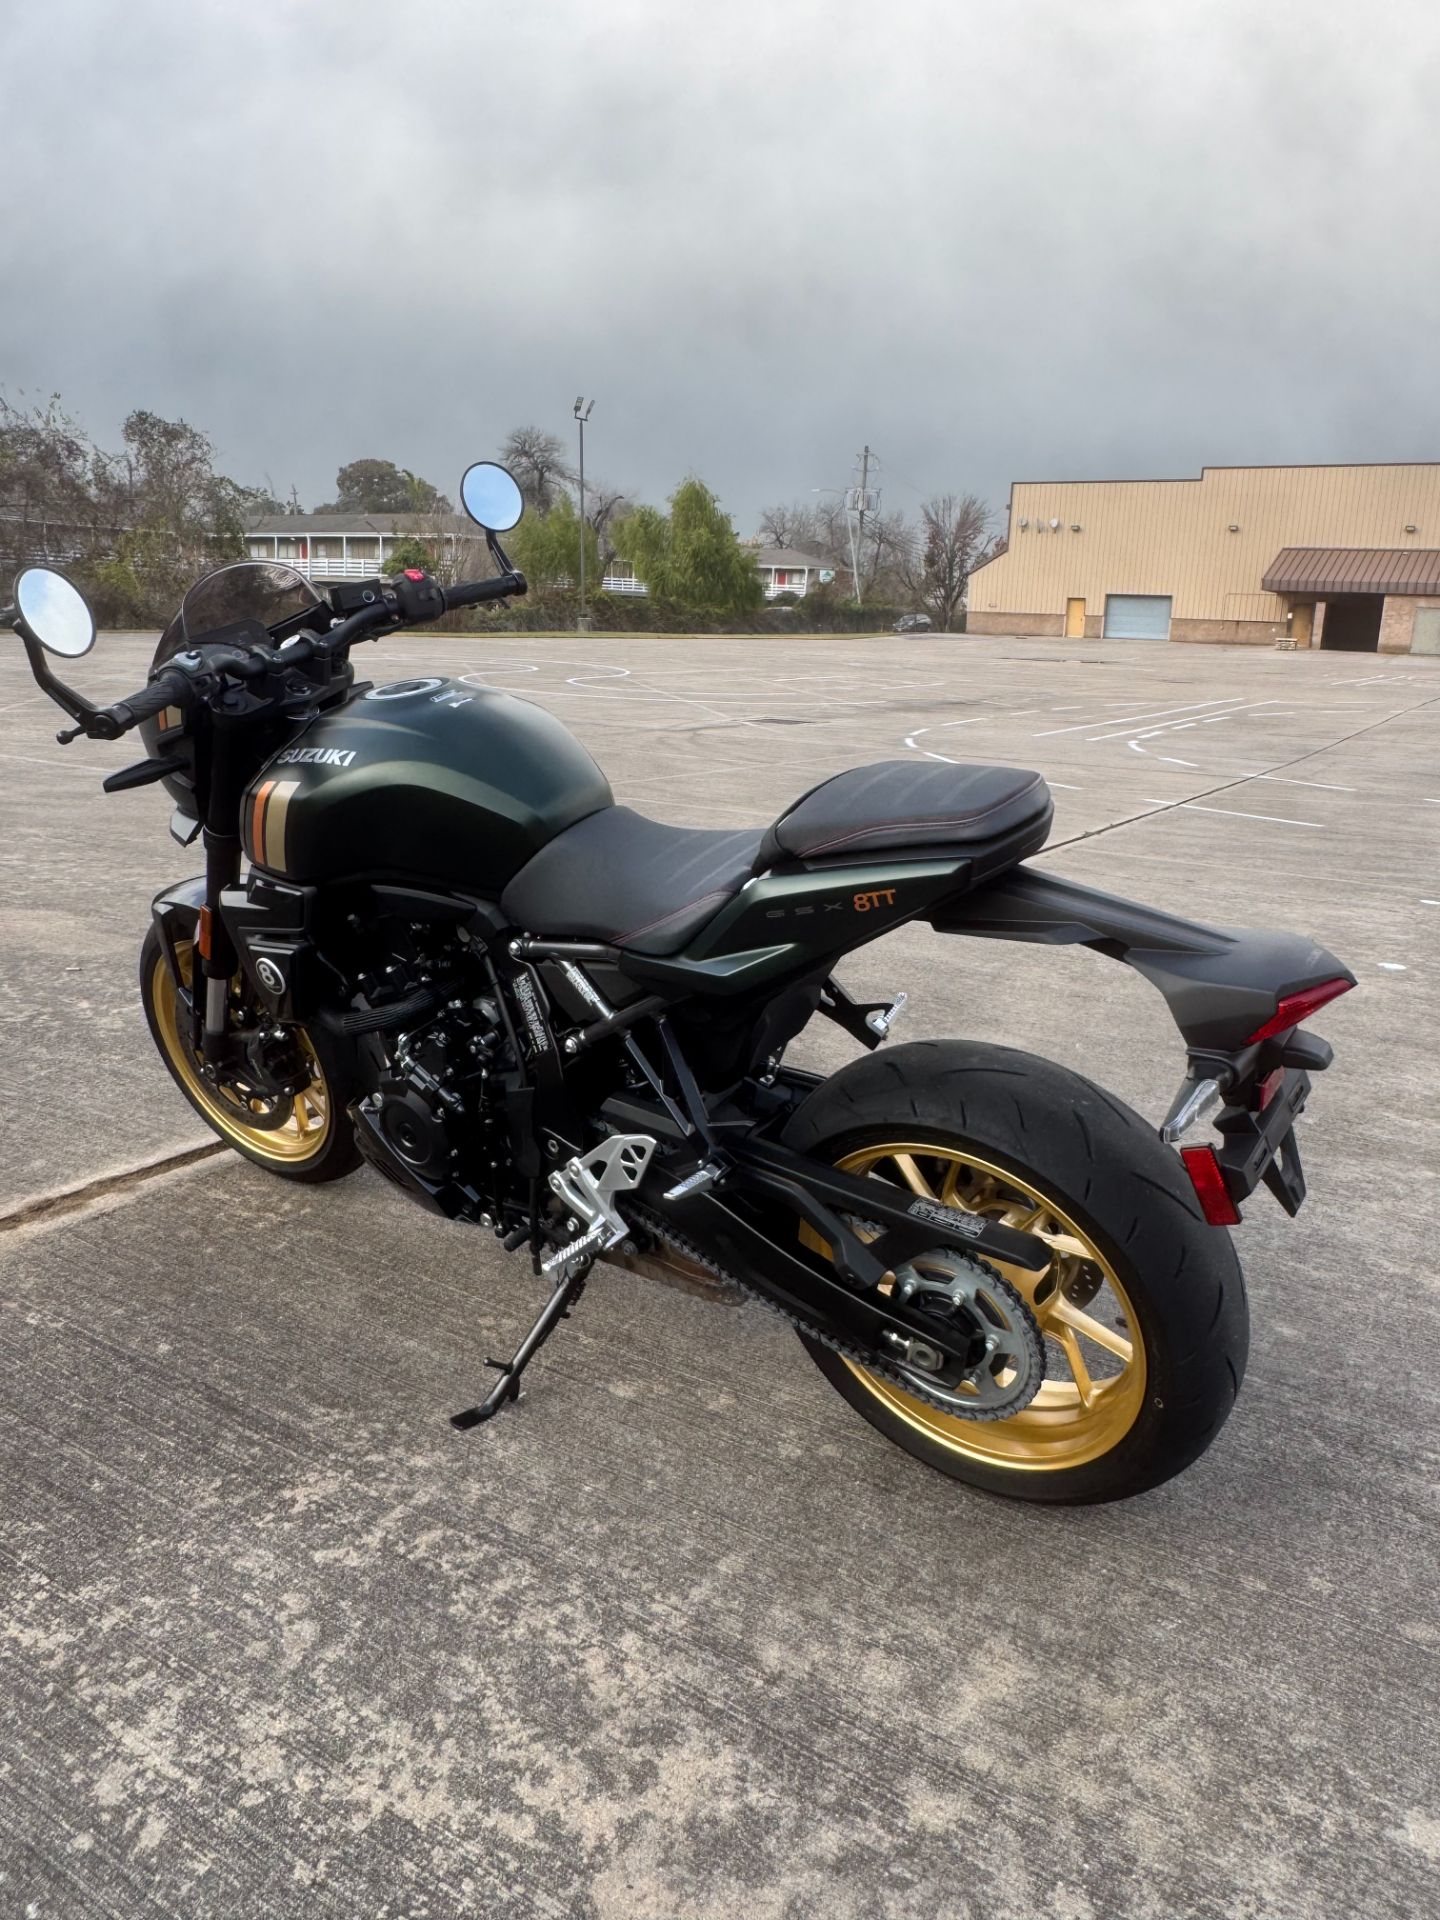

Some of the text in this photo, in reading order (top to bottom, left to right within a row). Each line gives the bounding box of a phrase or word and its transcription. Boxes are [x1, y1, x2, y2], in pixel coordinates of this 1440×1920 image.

[277, 747, 357, 767] SUZUKI
[853, 888, 896, 913] 8TT
[258, 964, 275, 986] 8
